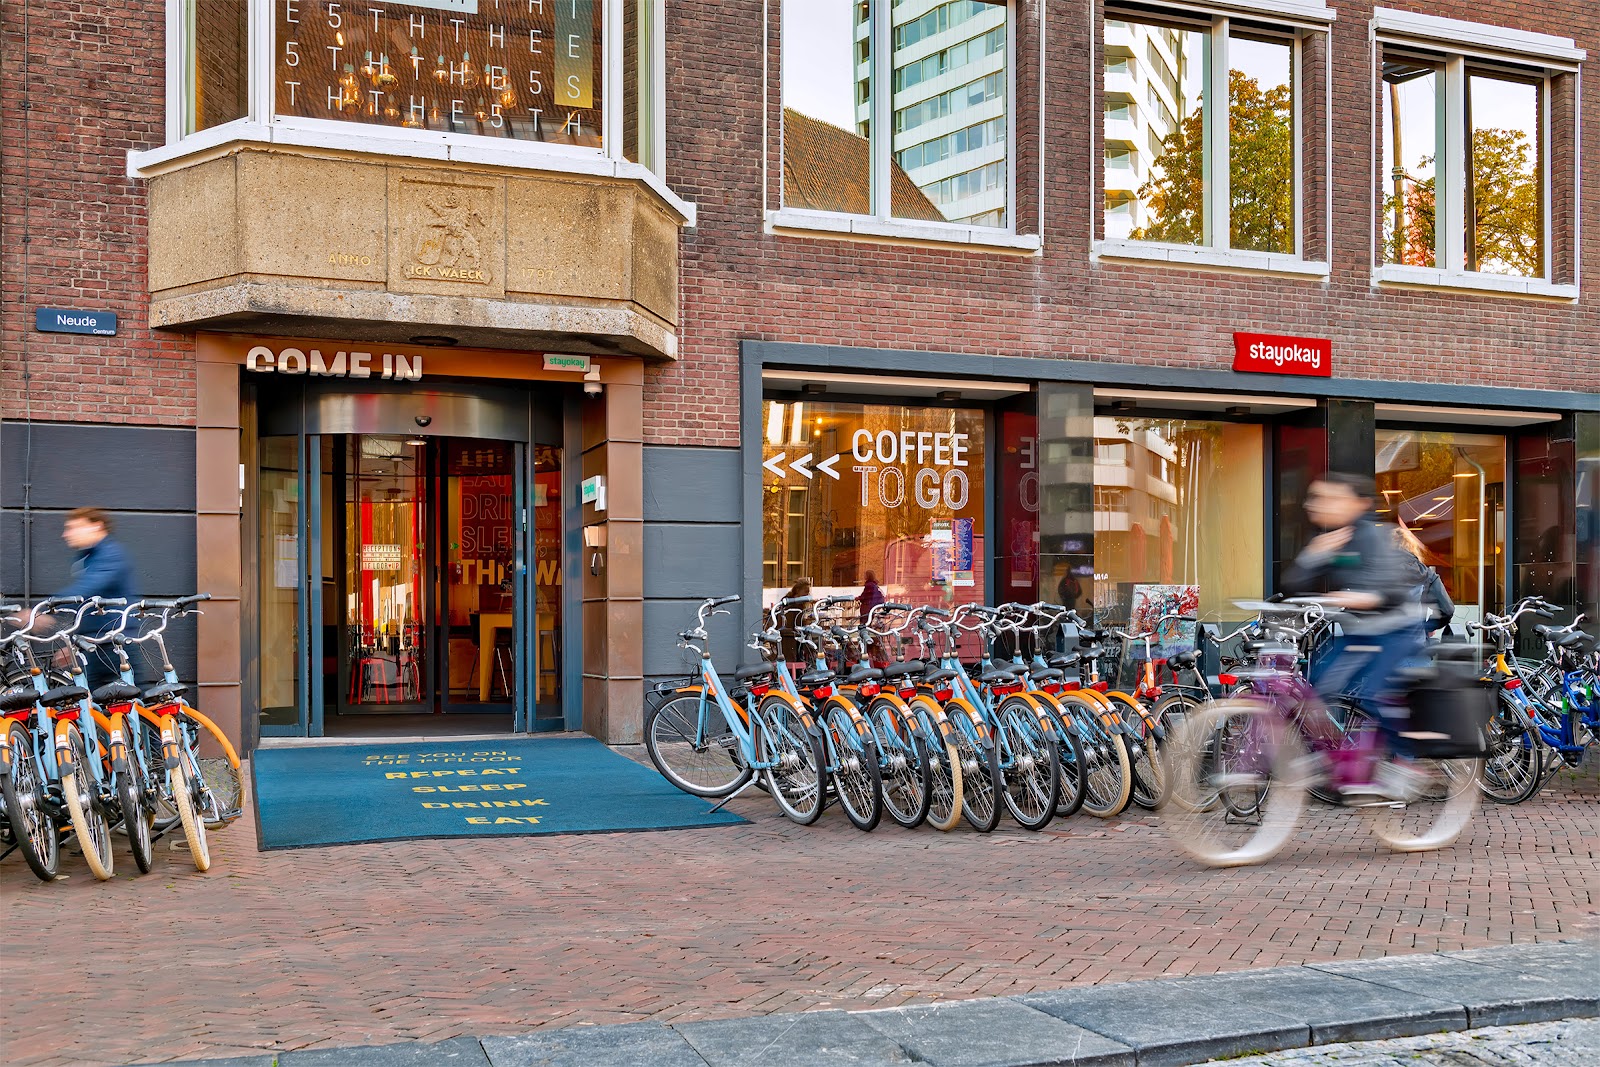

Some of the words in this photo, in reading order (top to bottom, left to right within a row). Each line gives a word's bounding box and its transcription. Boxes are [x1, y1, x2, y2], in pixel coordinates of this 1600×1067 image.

[328, 253, 371, 266] ANNO
[410, 266, 431, 276] ICK
[437, 267, 484, 280] WAECK
[57, 314, 97, 327] Neude
[1249, 341, 1321, 369] stayokay
[246, 346, 372, 378] COME
[381, 353, 423, 381] IN
[549, 357, 585, 369] stayokay
[852, 428, 969, 467] COFFEE
[852, 465, 905, 509] TO
[915, 467, 969, 510] GO
[385, 767, 522, 780] REPEAT
[412, 783, 527, 793] SLEEP
[421, 798, 550, 809] DRINK
[465, 816, 543, 824] EAT
